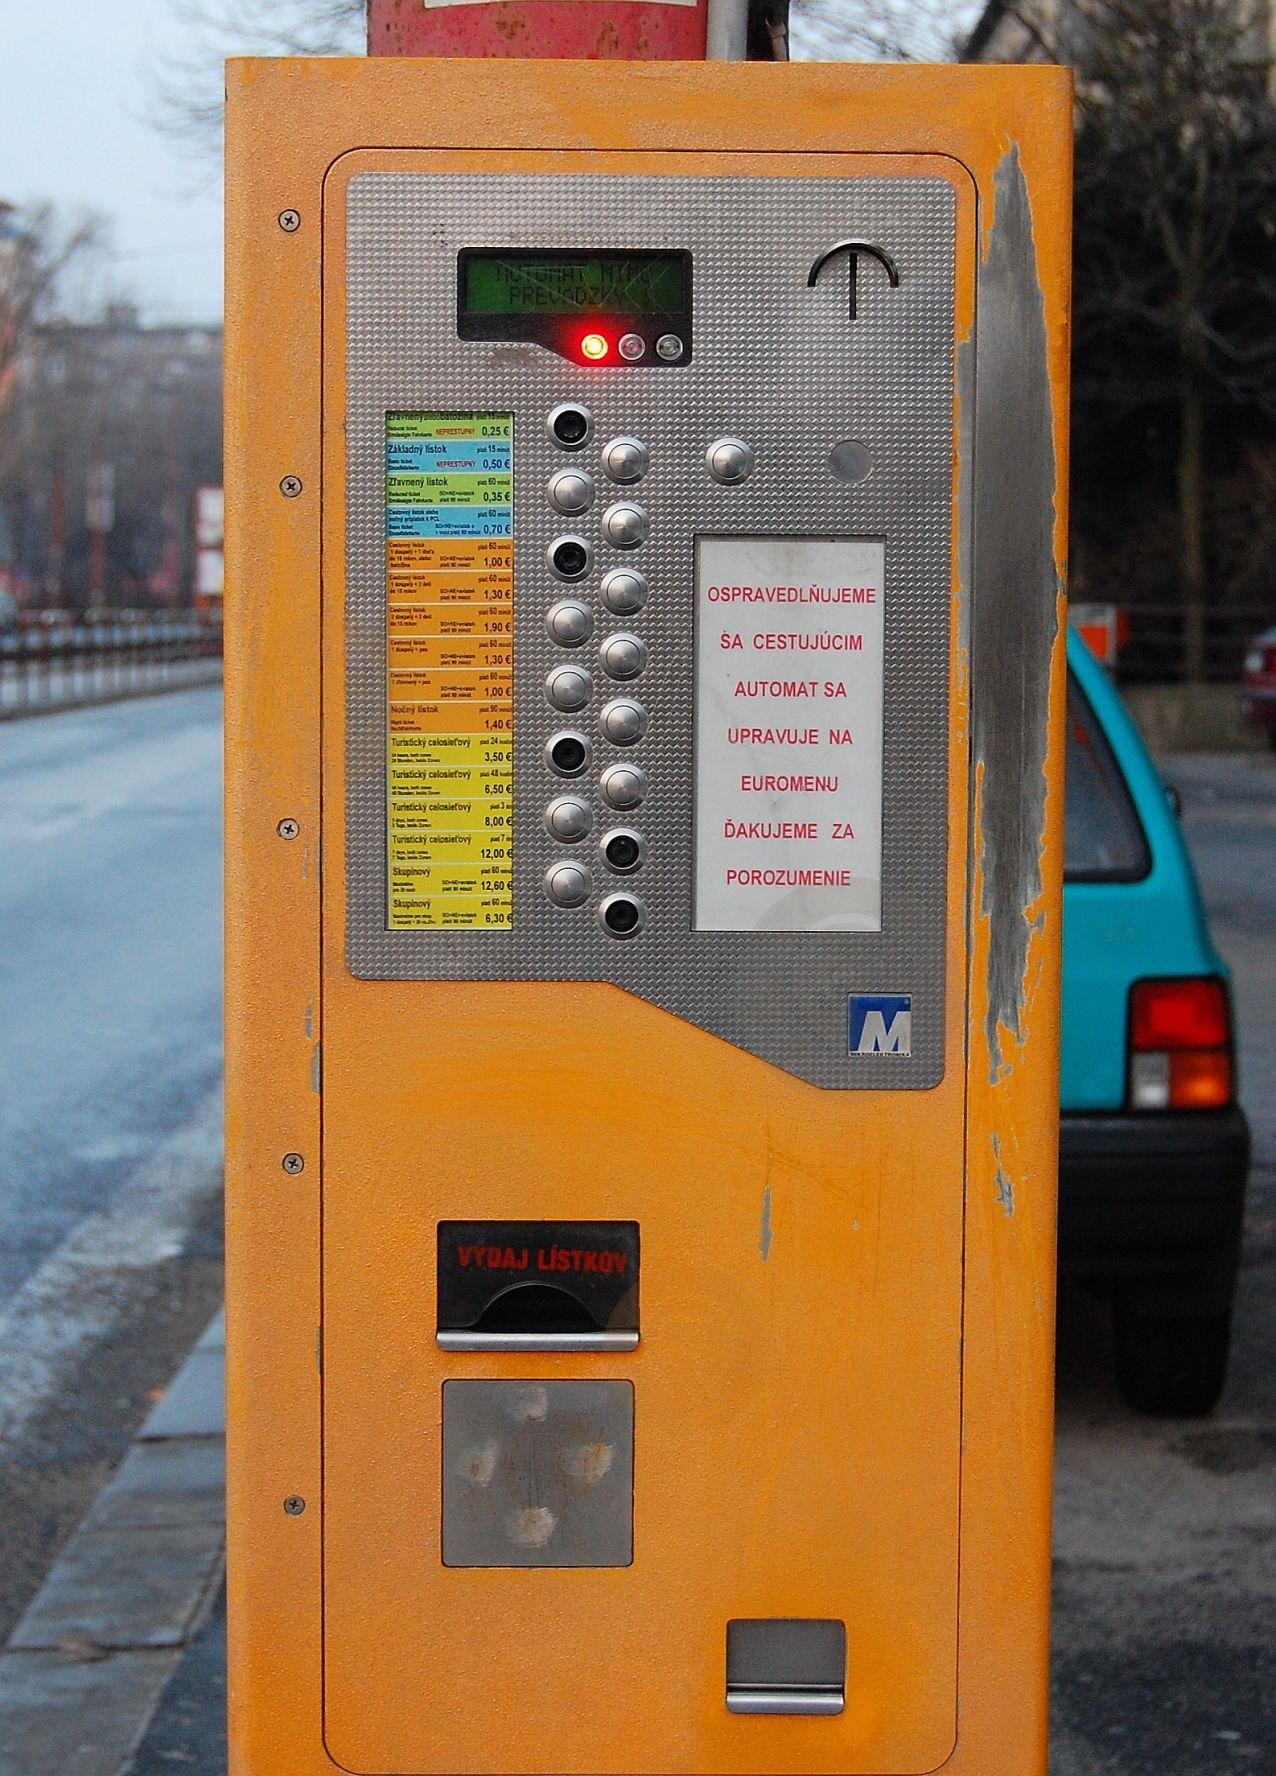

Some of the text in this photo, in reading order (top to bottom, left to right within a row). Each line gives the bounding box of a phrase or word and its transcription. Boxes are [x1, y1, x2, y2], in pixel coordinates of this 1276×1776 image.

[482, 427, 509, 437] 0,25 €
[388, 445, 447, 455] Základný lístok
[483, 459, 511, 470] 0,50 €
[388, 477, 424, 488] Zľavnený
[488, 477, 496, 485] 60
[483, 492, 511, 503] 0,35 €
[483, 524, 502, 535] 0,70
[505, 524, 511, 534] €
[488, 542, 496, 550] 60
[484, 557, 511, 568] 1,00 €
[484, 589, 502, 600] 1,30
[505, 590, 511, 599] €
[707, 584, 876, 604] OSPRAVEDLŇUJEME
[484, 622, 502, 633] 1,90
[505, 622, 511, 632] €
[753, 630, 863, 650] CESTUJÚCIM
[484, 655, 502, 665] 1,30
[505, 655, 511, 664] €
[484, 687, 503, 698] 1,00
[505, 687, 511, 696] €
[734, 681, 848, 698] AUTOMAT SA
[391, 705, 415, 715] Nočný
[485, 719, 512, 730] 1,40 €
[727, 728, 853, 745] UPRAVUJE NA
[392, 737, 471, 748] Turistický celosieťový
[484, 752, 512, 763] 3,50 €
[392, 770, 471, 780] Turistický celosieťový
[490, 769, 499, 777] 48
[741, 775, 839, 792] EUROMENU
[484, 784, 512, 795] 6,50 €
[392, 802, 471, 813] Turistický celosieťový
[485, 816, 512, 827] 8,00 €
[723, 819, 854, 840] ĎAKUJEME ZA
[392, 835, 471, 845] Turistický celosieťový
[481, 849, 512, 860] 12,00 €
[393, 867, 431, 877] Skupinový
[726, 869, 851, 886] POROZUMENIE
[481, 881, 504, 892] 12,60
[507, 881, 512, 891] €
[393, 899, 431, 909] Skupinový
[485, 914, 512, 924] 6,30 €
[858, 1010, 912, 1052] M
